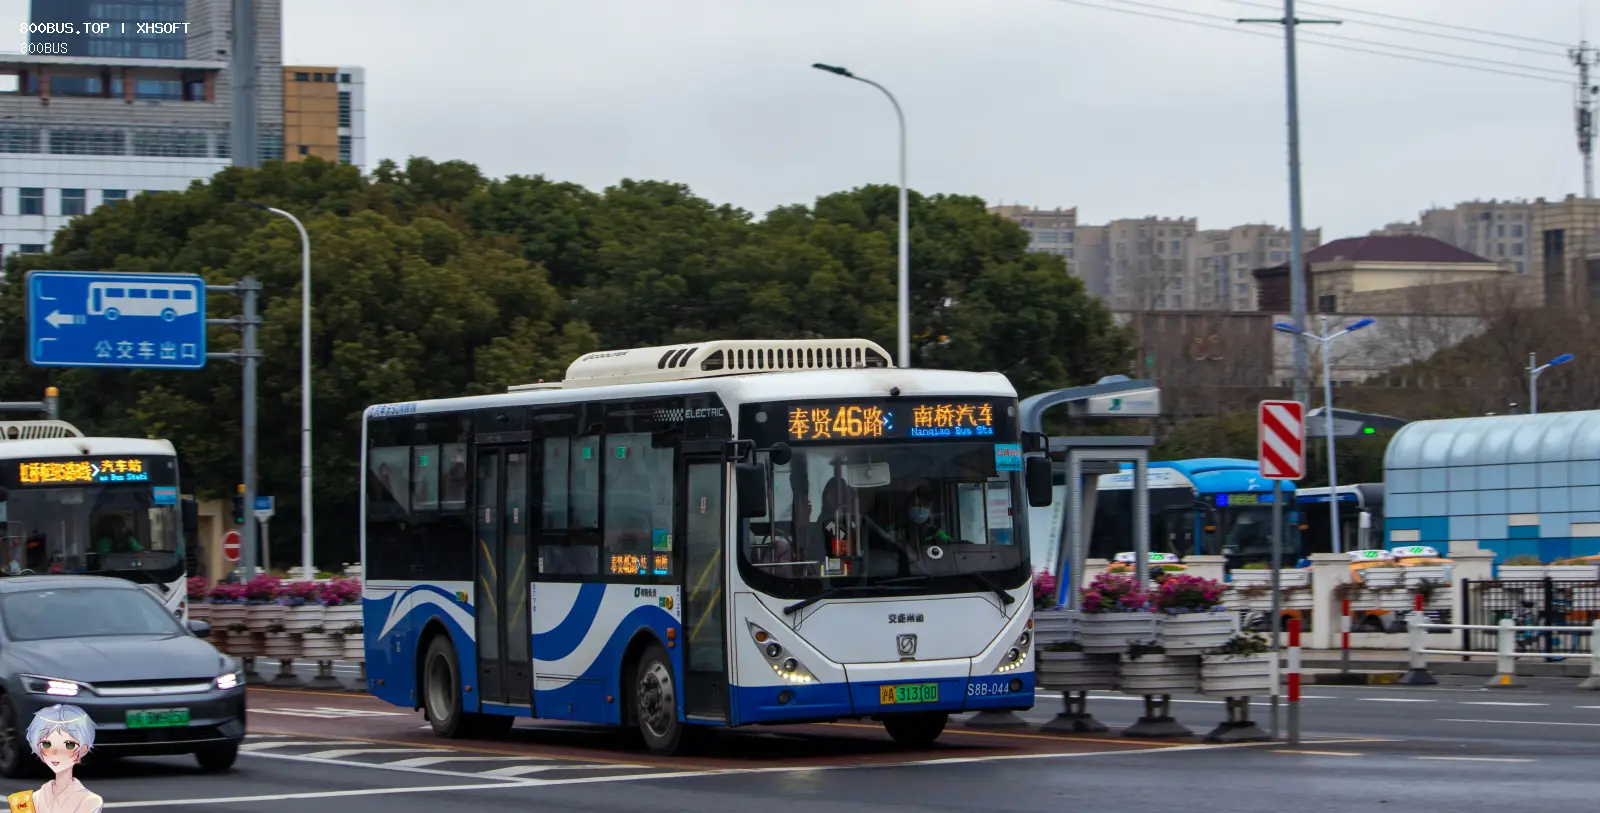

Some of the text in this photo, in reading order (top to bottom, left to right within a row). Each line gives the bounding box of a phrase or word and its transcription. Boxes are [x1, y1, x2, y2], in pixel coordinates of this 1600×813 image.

[95, 340, 197, 360] 公交车出口
[685, 407, 724, 419] ELECTRIC
[788, 403, 993, 440] 奉贤46路 南桥汽车
[911, 427, 951, 437] Nanqiao
[955, 427, 972, 436] Bus
[100, 460, 142, 473] 汽车站
[967, 682, 1010, 697] S8B-044
